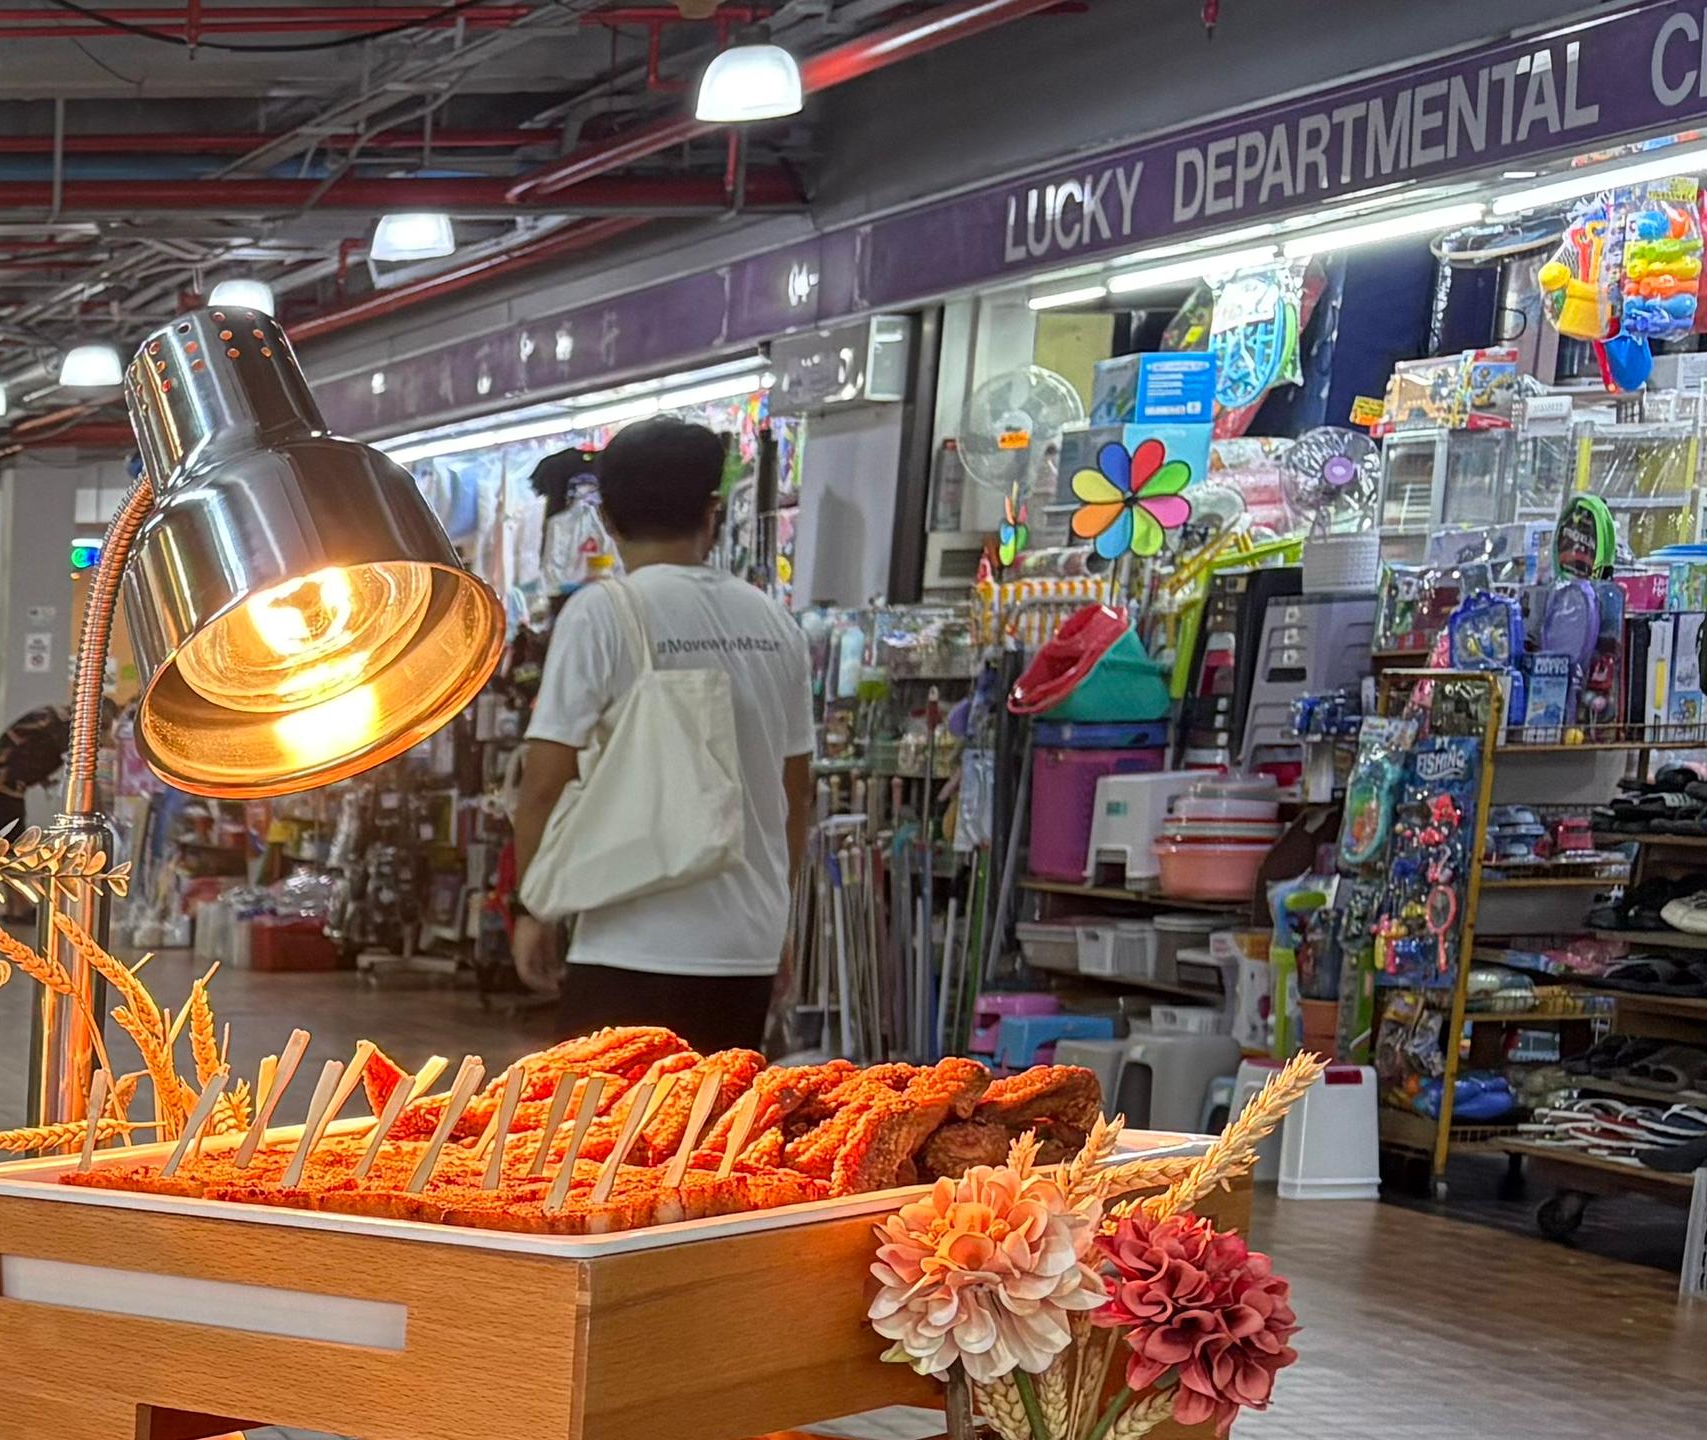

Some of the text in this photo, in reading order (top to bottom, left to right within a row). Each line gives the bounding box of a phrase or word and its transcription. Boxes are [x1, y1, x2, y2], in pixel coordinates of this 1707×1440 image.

[1004, 162, 1143, 263] LUCKY
[1174, 41, 1599, 224] DEPARTMENTAL
[1416, 750, 1468, 774] FISHING
